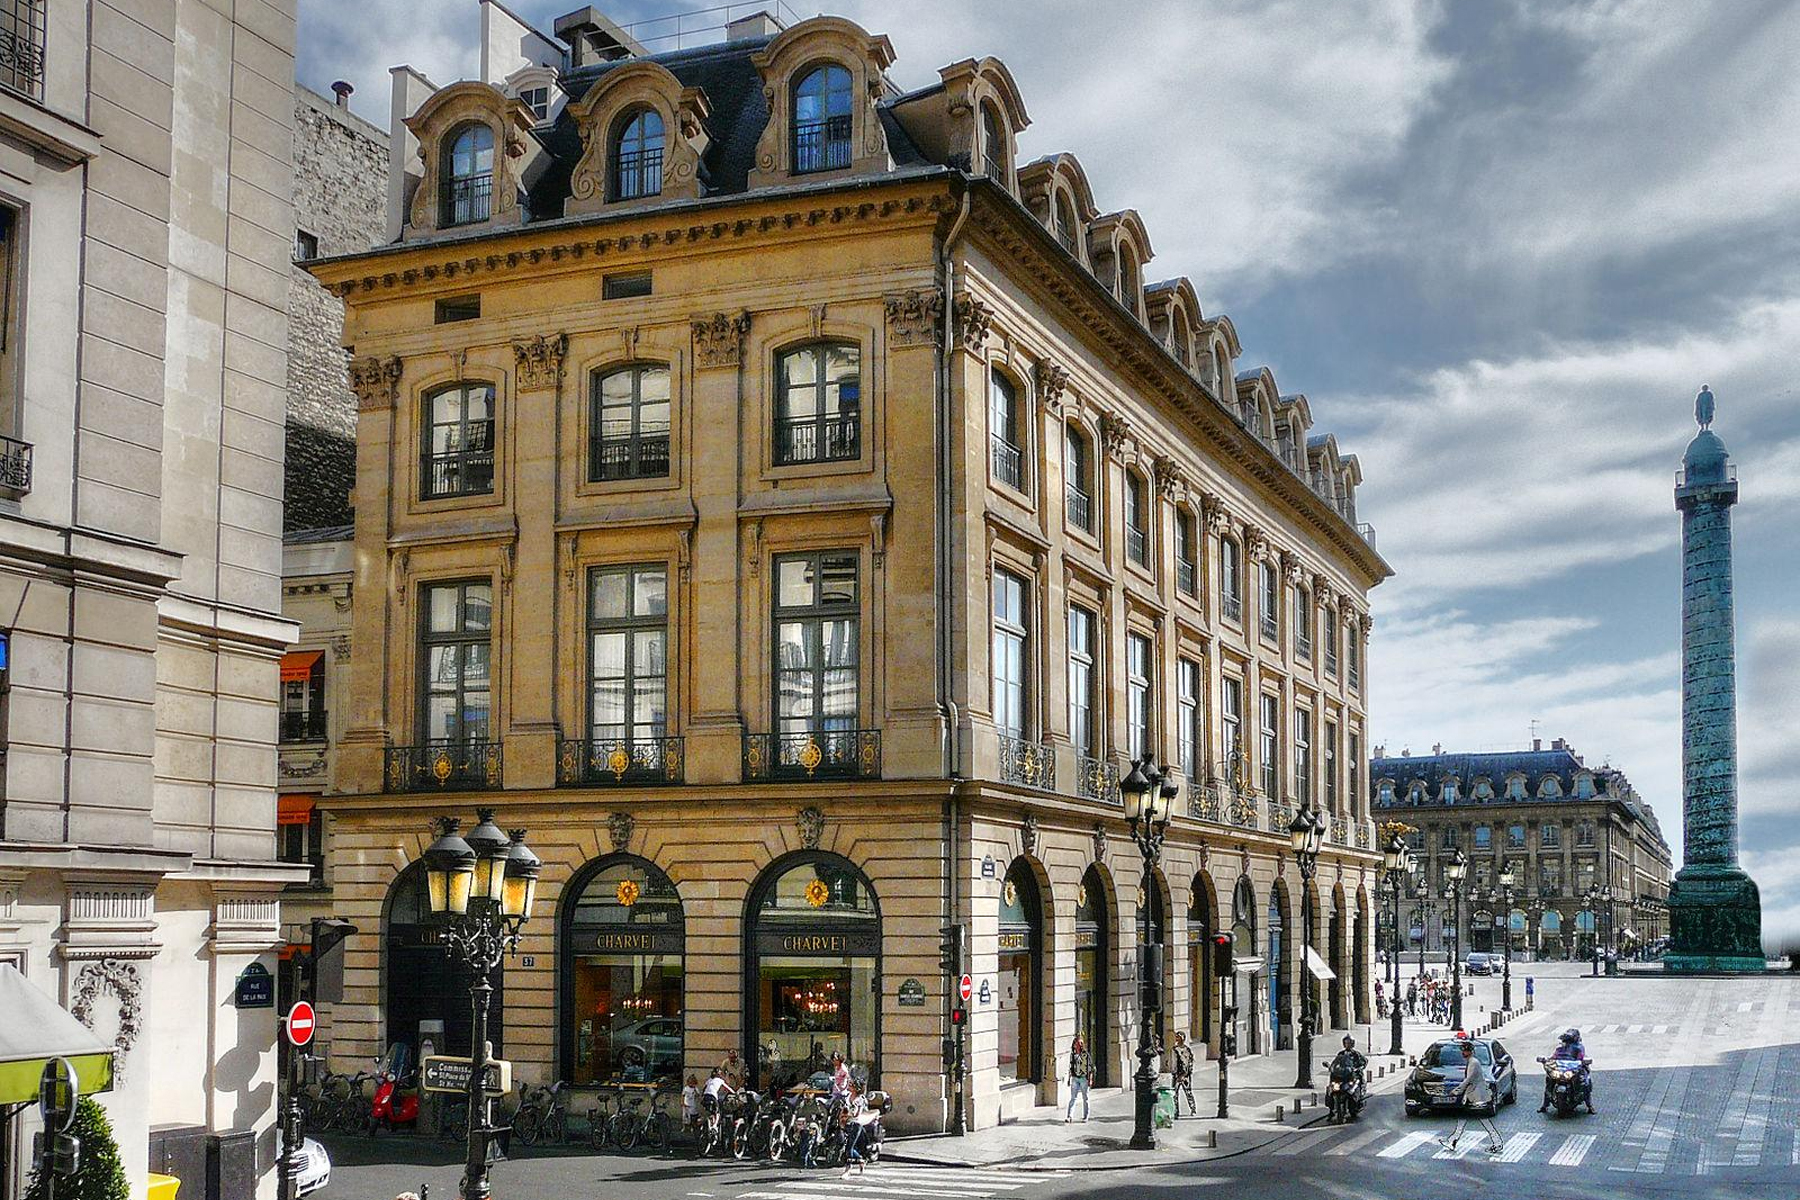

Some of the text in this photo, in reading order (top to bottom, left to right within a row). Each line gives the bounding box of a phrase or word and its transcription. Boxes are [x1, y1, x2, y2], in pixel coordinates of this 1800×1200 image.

[597, 934, 656, 949] CHARVET
[783, 936, 847, 951] CHARVET
[523, 957, 533, 966] 37
